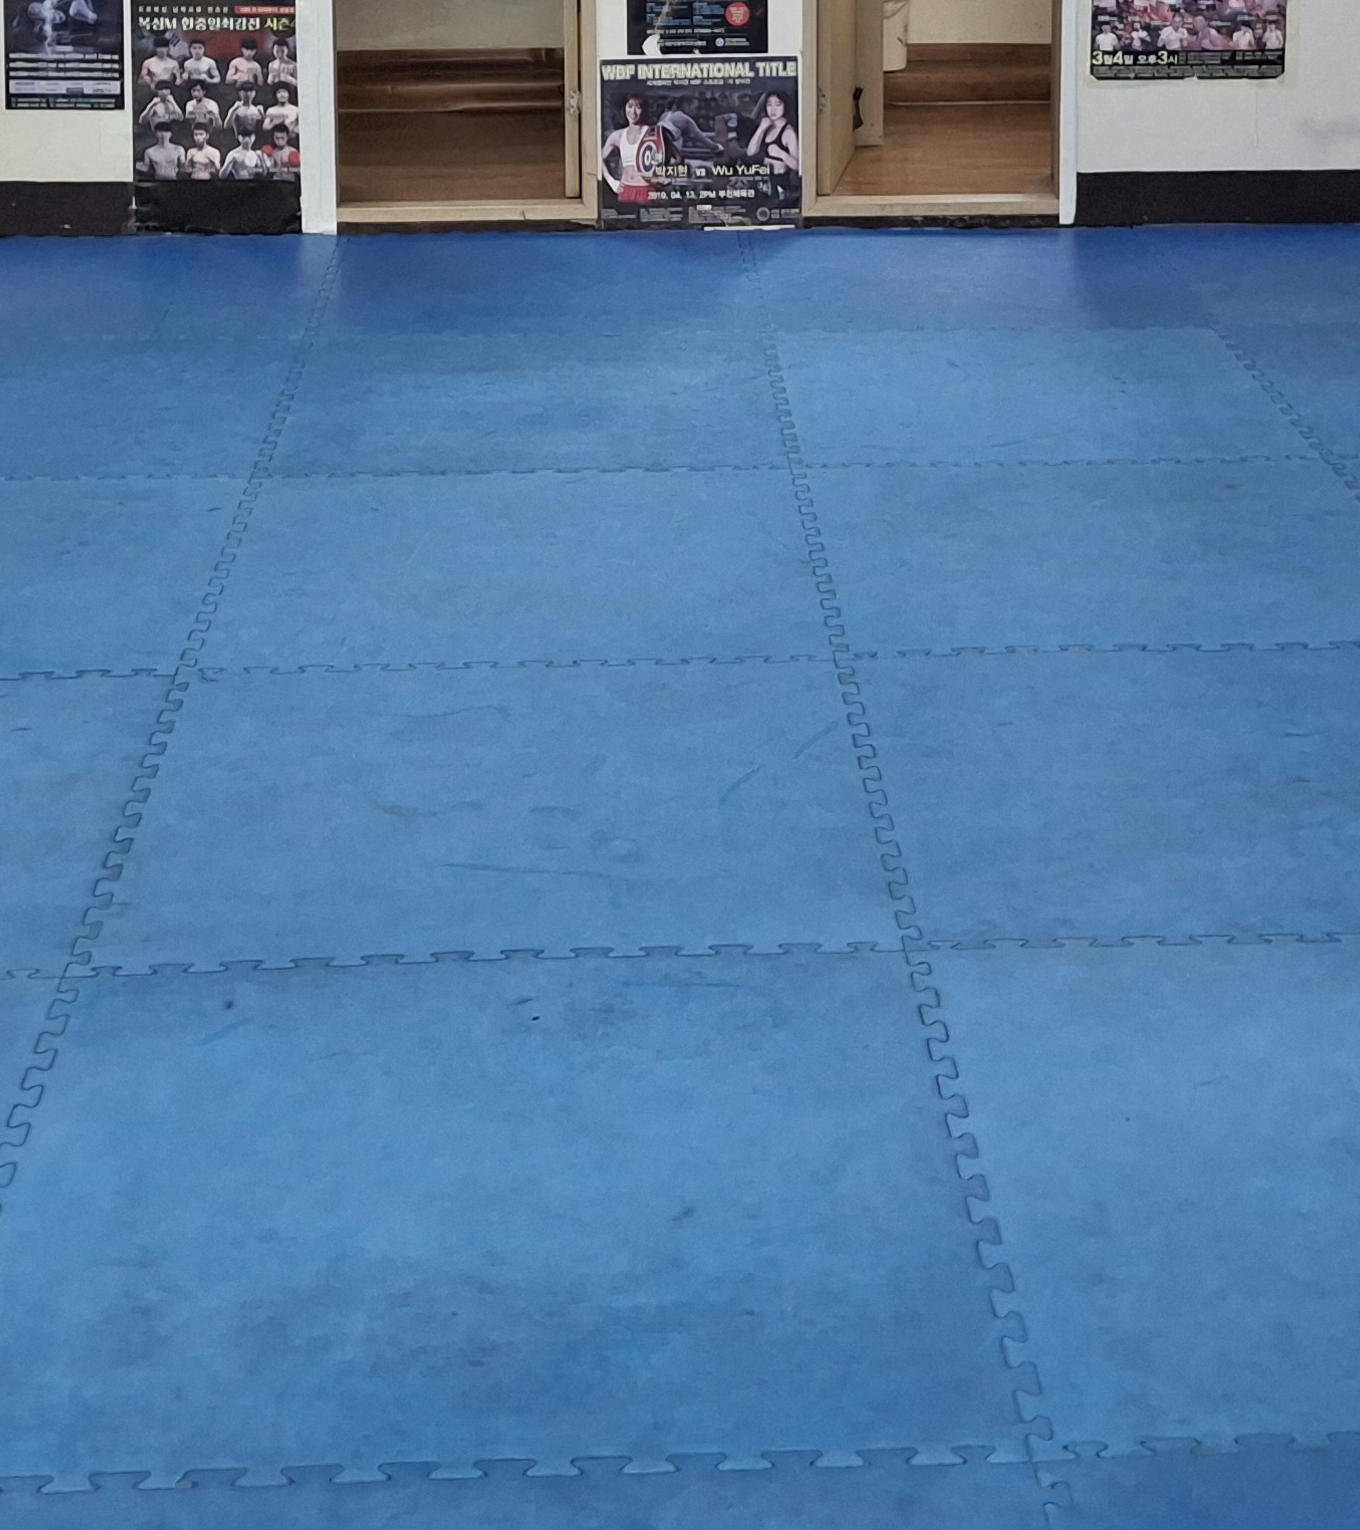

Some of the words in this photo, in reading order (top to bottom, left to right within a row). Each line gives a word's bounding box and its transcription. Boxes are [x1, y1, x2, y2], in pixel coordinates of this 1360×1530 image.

[1092, 50, 1134, 65] 3월4일
[1136, 50, 1179, 65] 오후3시
[601, 64, 635, 81] WBF
[637, 62, 755, 80] INTERNATIONAL
[755, 61, 798, 77] TITLE
[712, 165, 733, 176] Wu
[737, 164, 770, 176] YuFei
